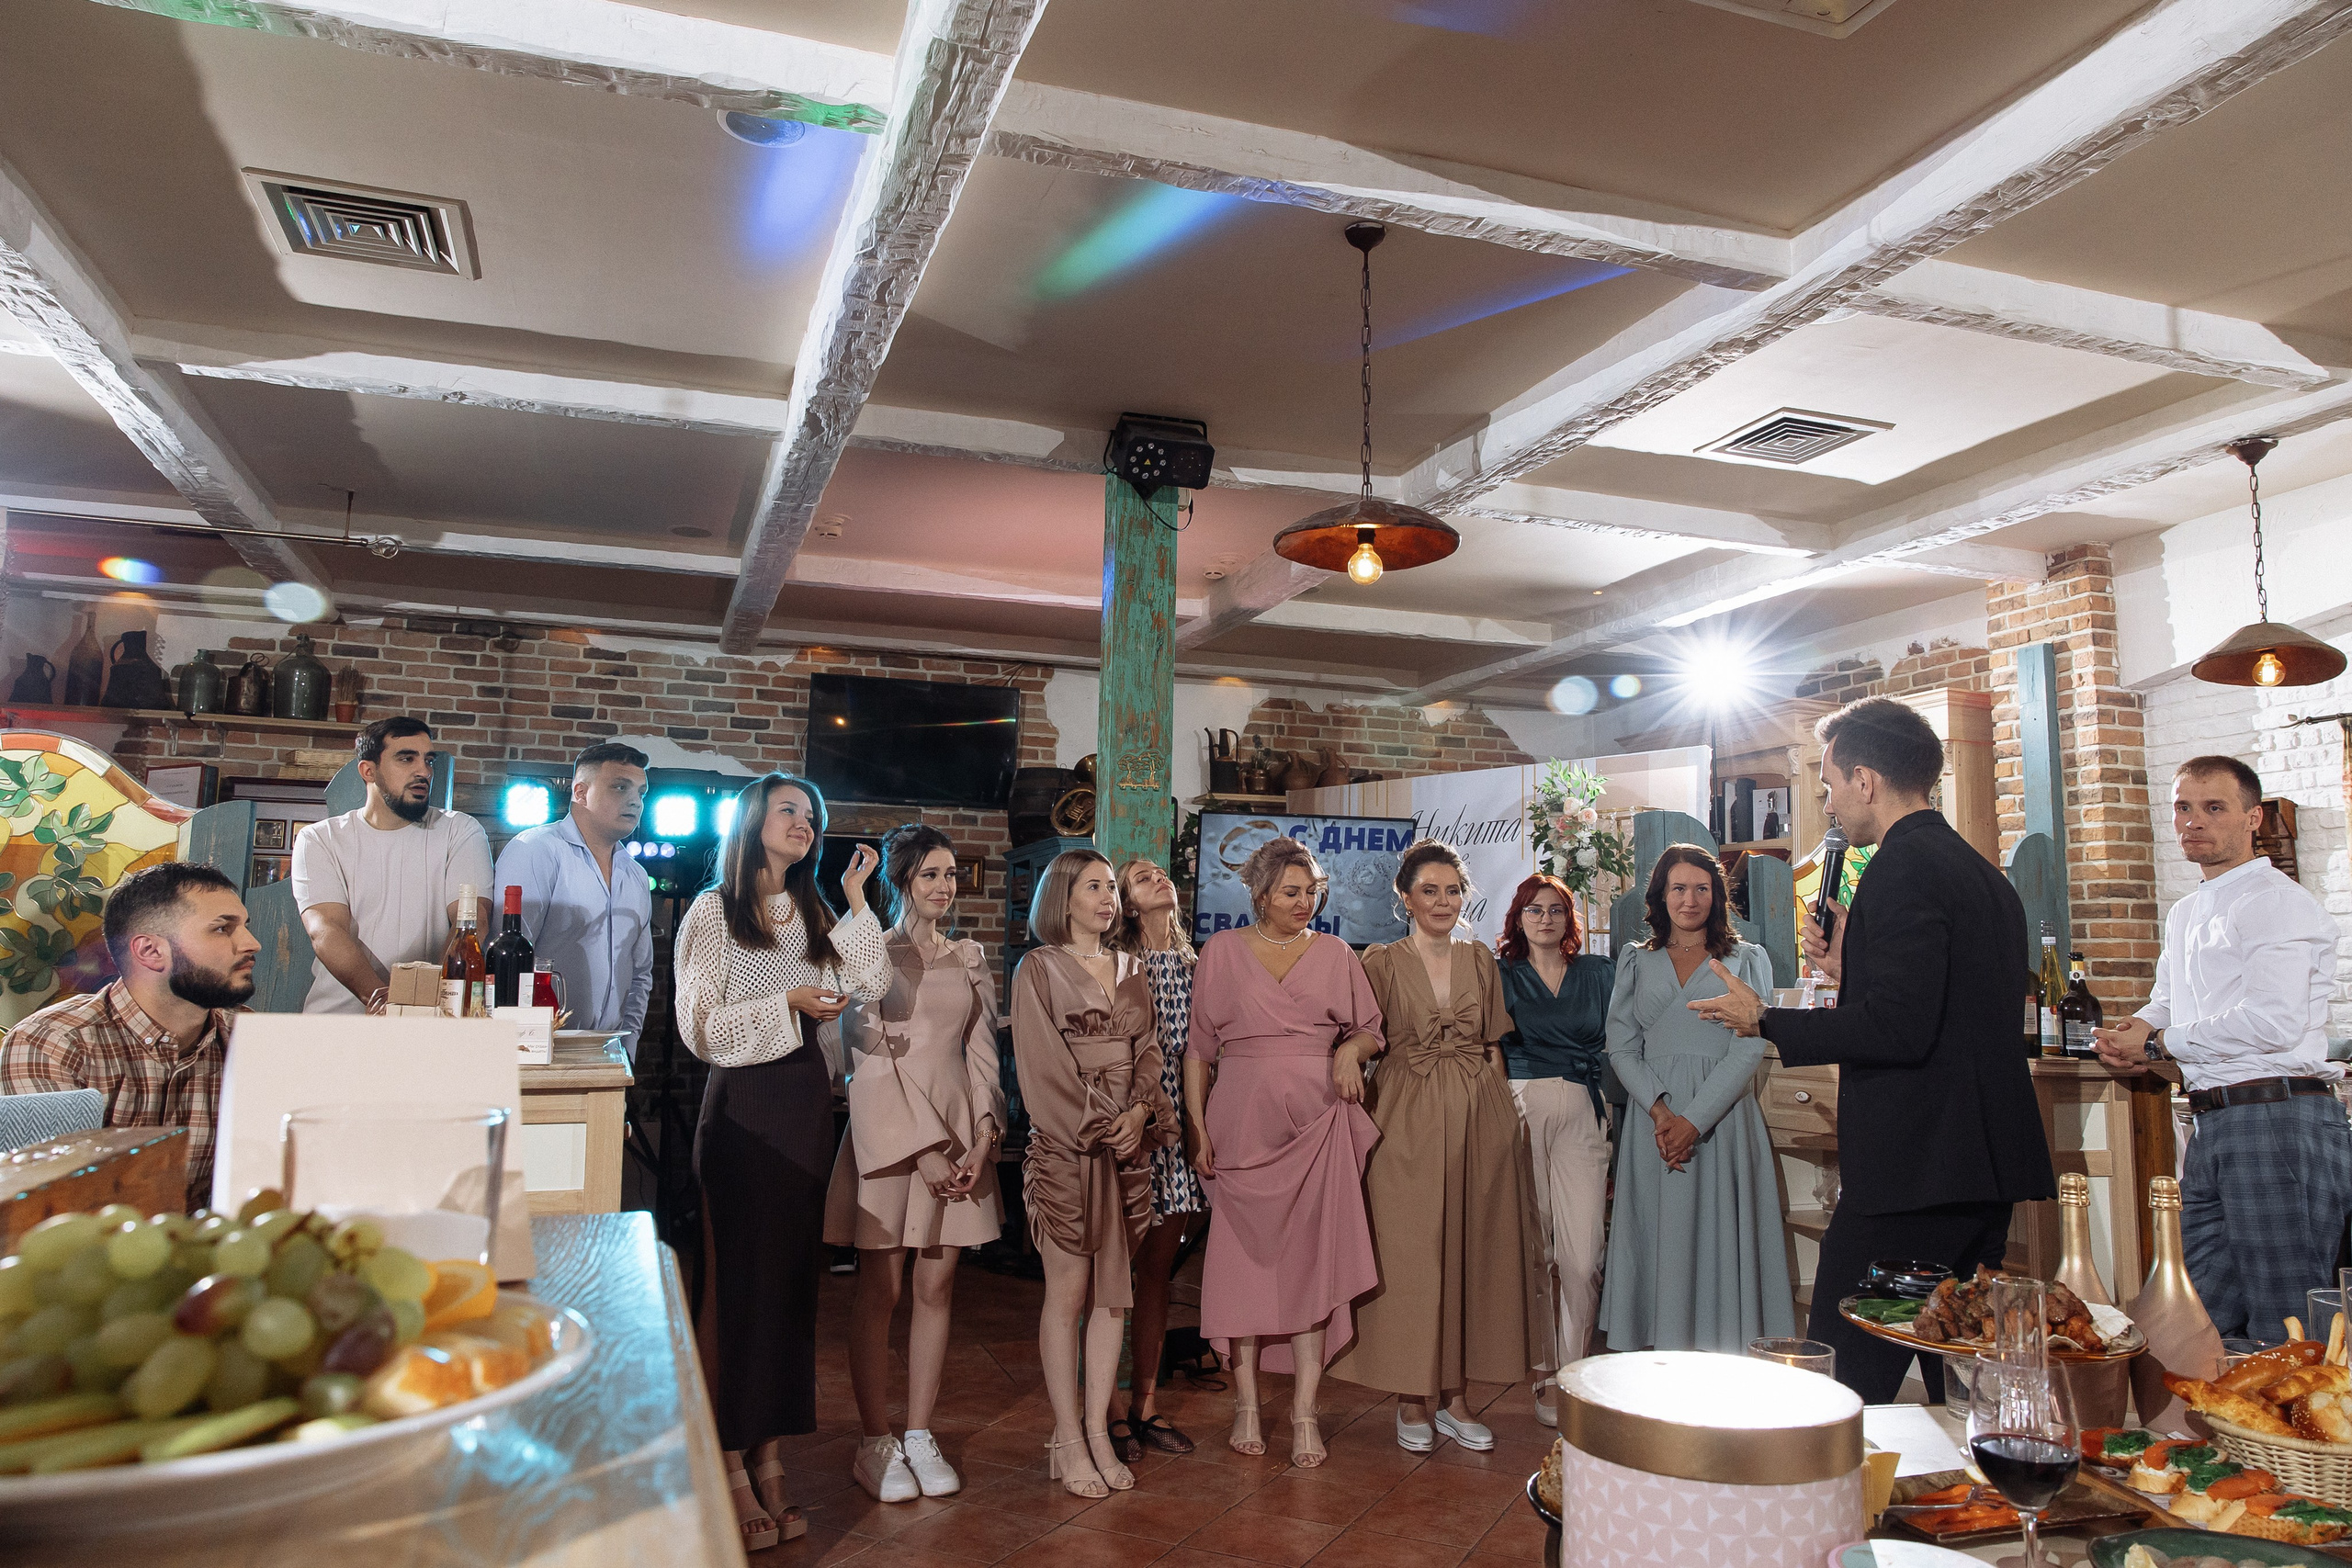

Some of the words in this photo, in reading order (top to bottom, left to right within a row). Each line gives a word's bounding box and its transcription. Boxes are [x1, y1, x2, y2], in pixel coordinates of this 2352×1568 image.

[1288, 824, 1308, 847] С
[1318, 826, 1414, 854] ДНЕМ
[1410, 804, 1521, 847] Никита
[1195, 912, 1340, 936] СВАЫ
